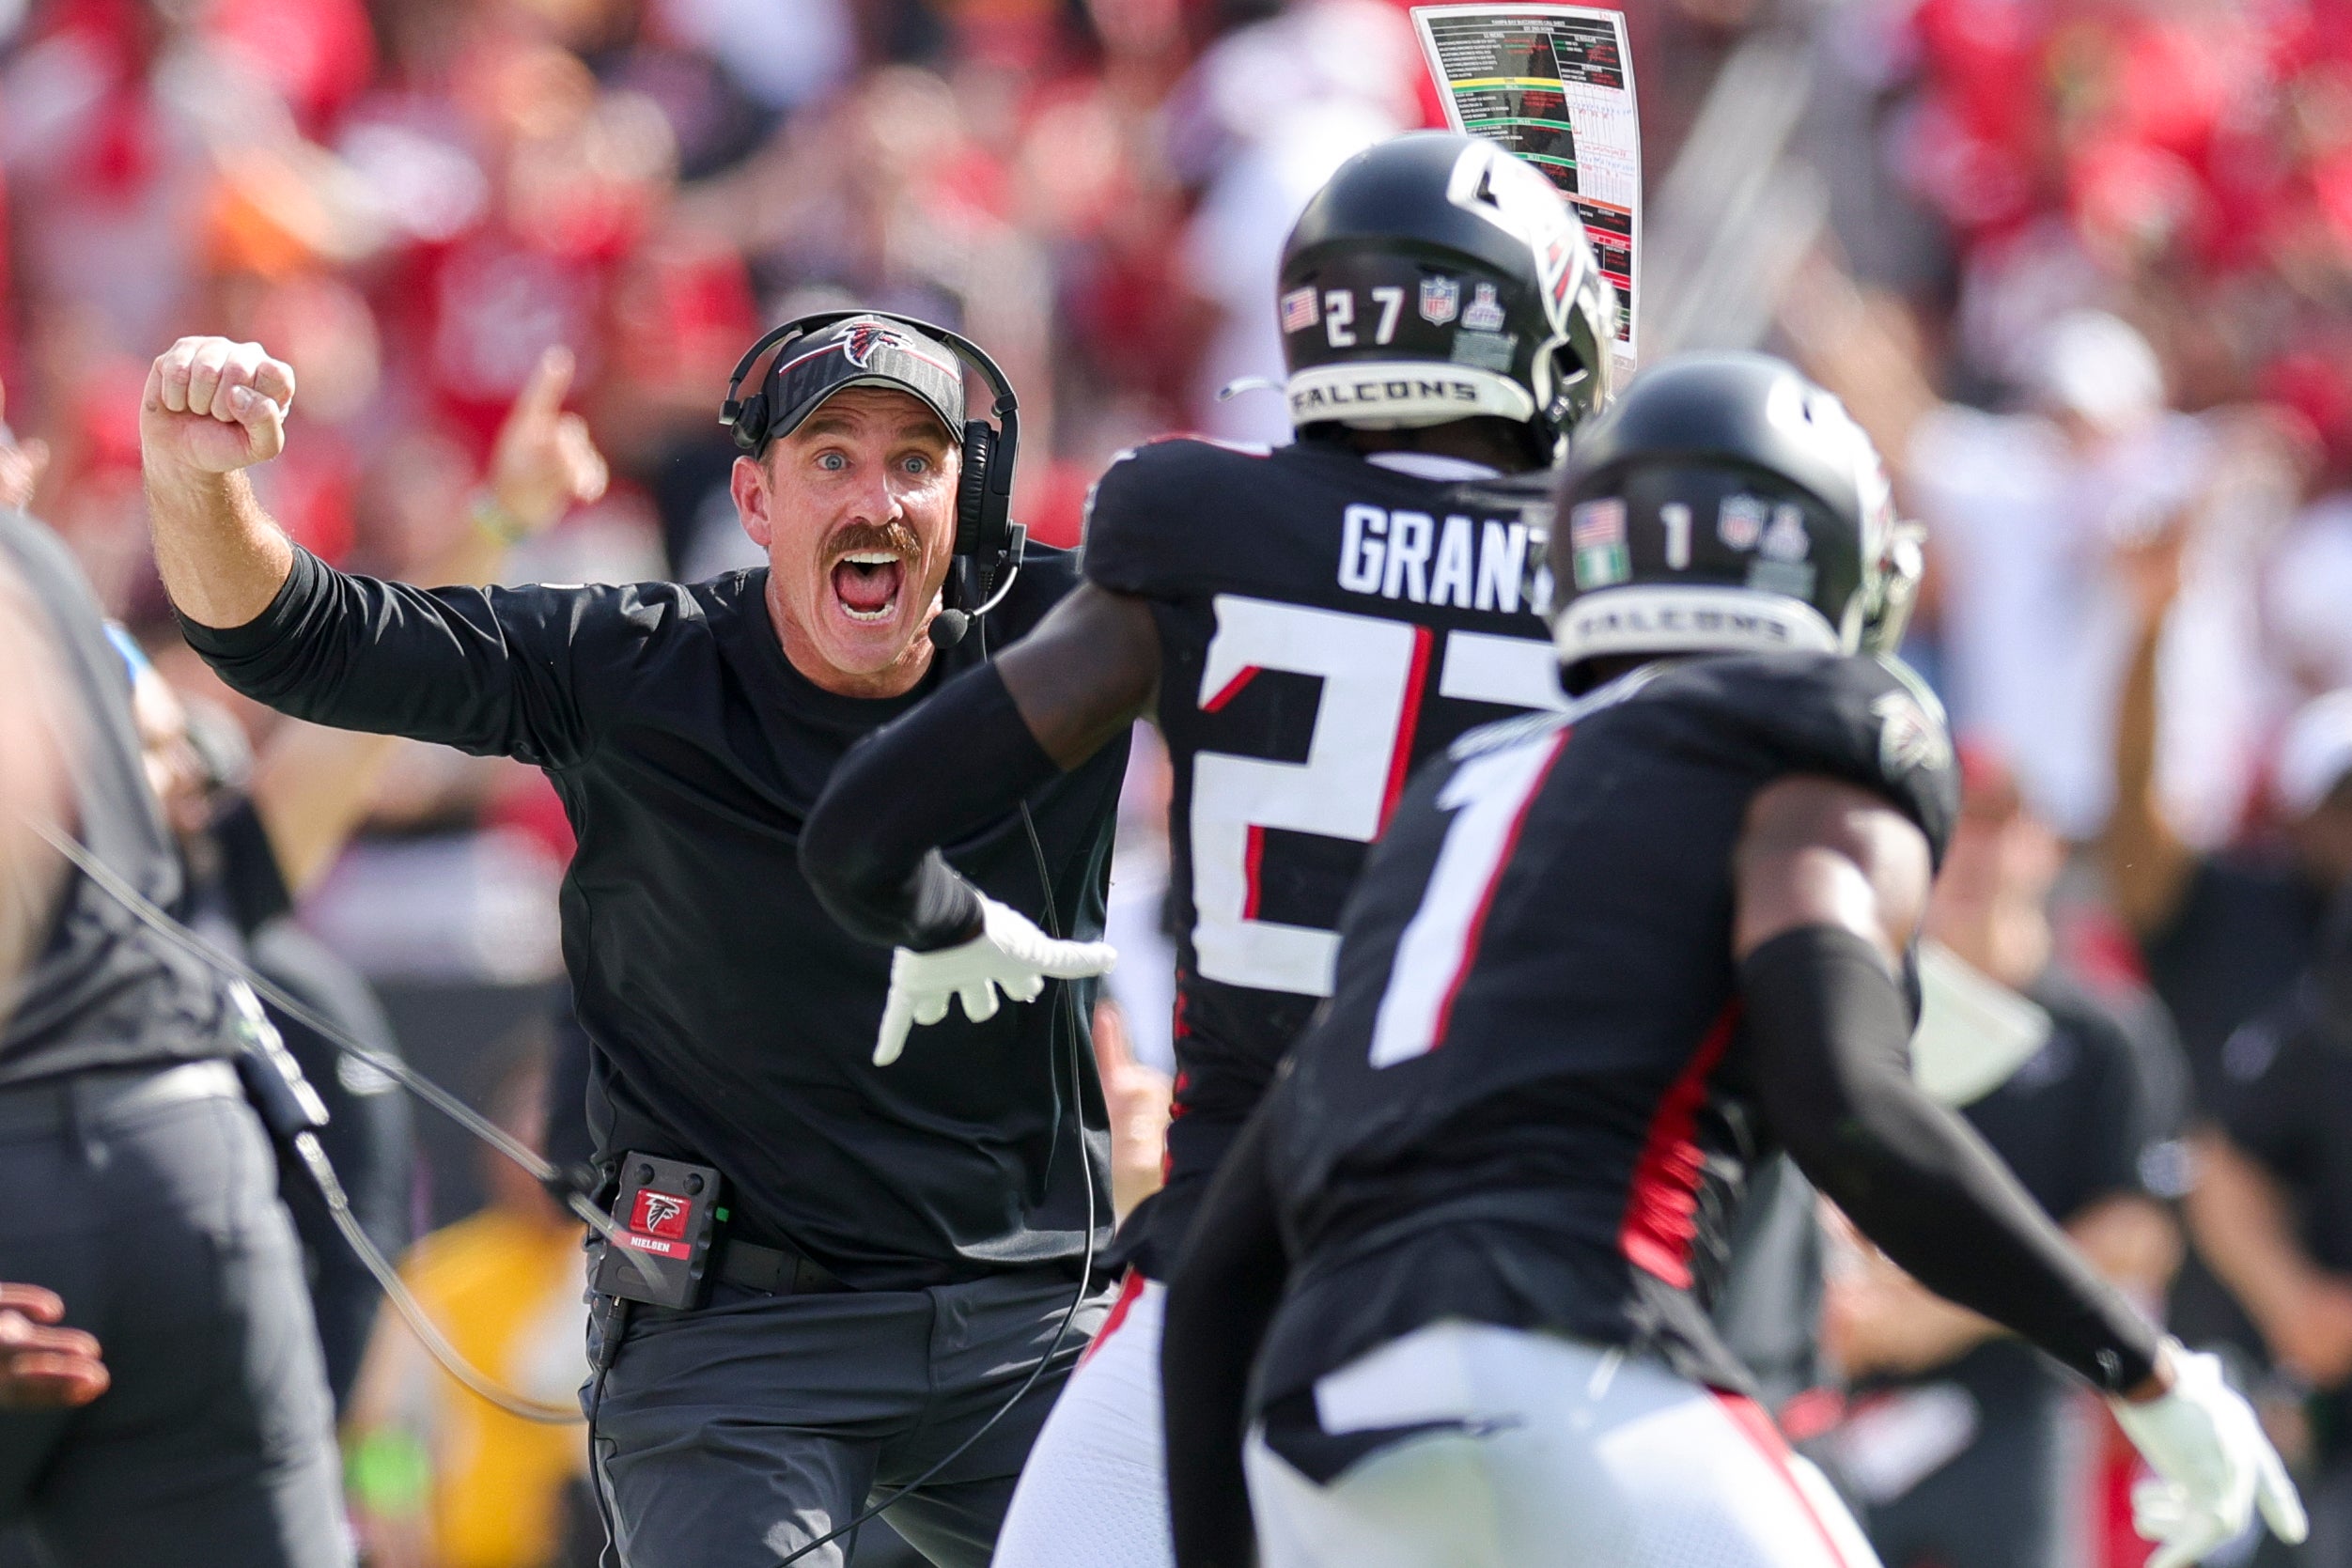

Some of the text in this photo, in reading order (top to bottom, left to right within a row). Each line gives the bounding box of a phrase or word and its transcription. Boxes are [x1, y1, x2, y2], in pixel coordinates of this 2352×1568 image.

[1324, 286, 1405, 348] 27
[1290, 380, 1478, 411] FALCONS
[1659, 502, 1693, 571] 1
[1369, 728, 1572, 1068] 1
[631, 1235, 671, 1253] NIELSEN
